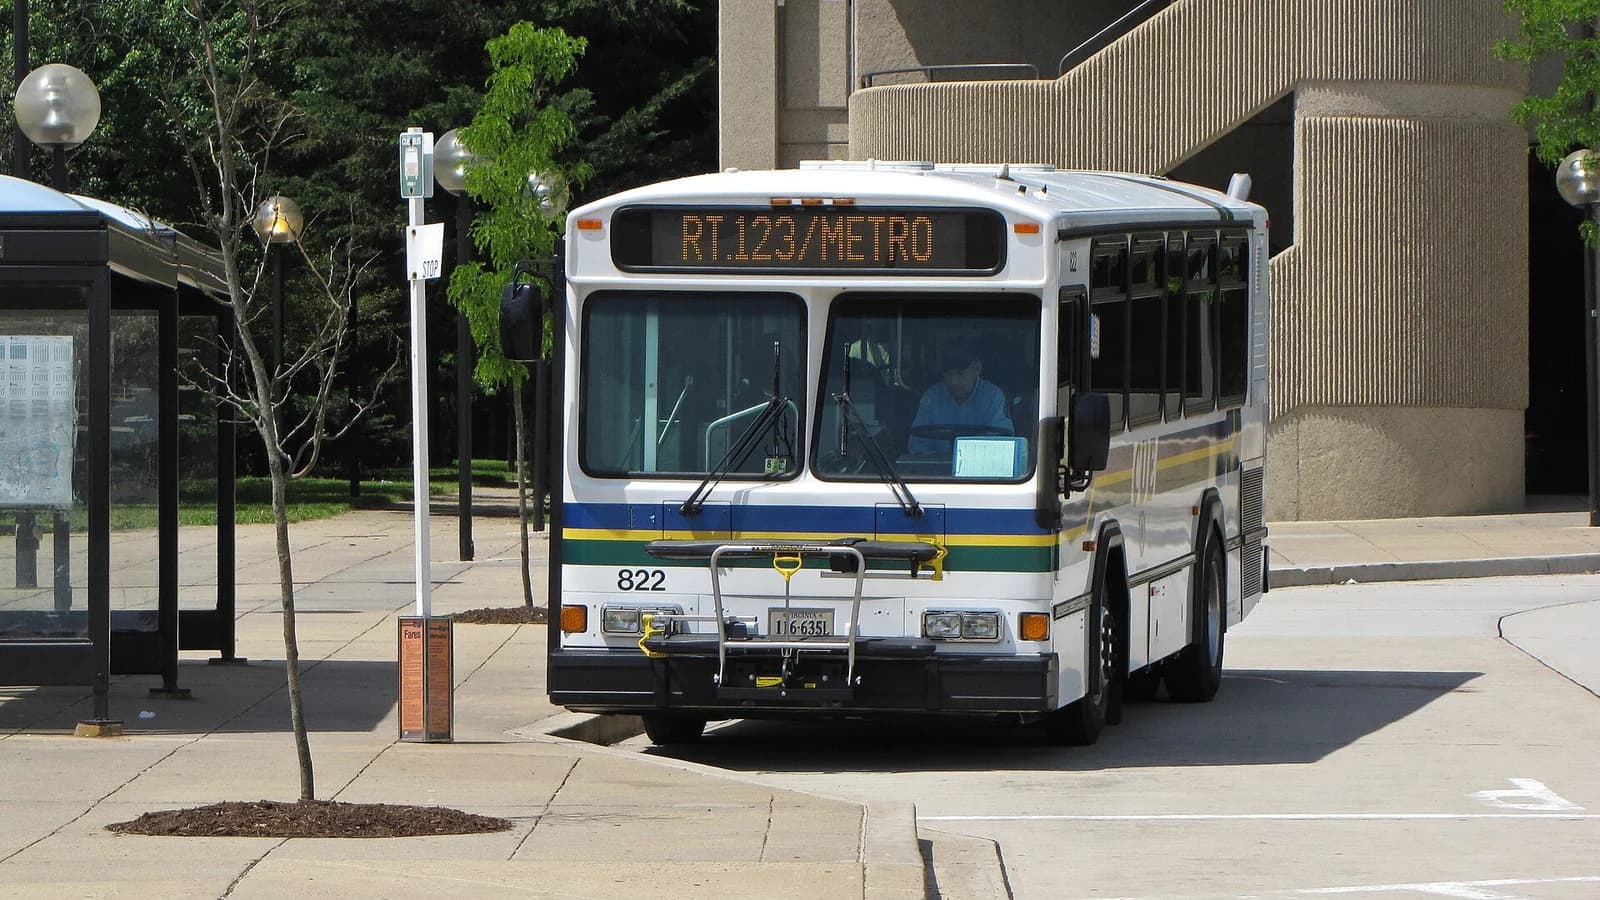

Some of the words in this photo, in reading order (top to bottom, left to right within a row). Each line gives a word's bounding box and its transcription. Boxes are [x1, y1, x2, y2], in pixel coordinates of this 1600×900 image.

[682, 215, 934, 261] RT.123/METRO
[423, 260, 437, 278] STOP
[617, 569, 666, 591] 822
[404, 630, 421, 640] Fares
